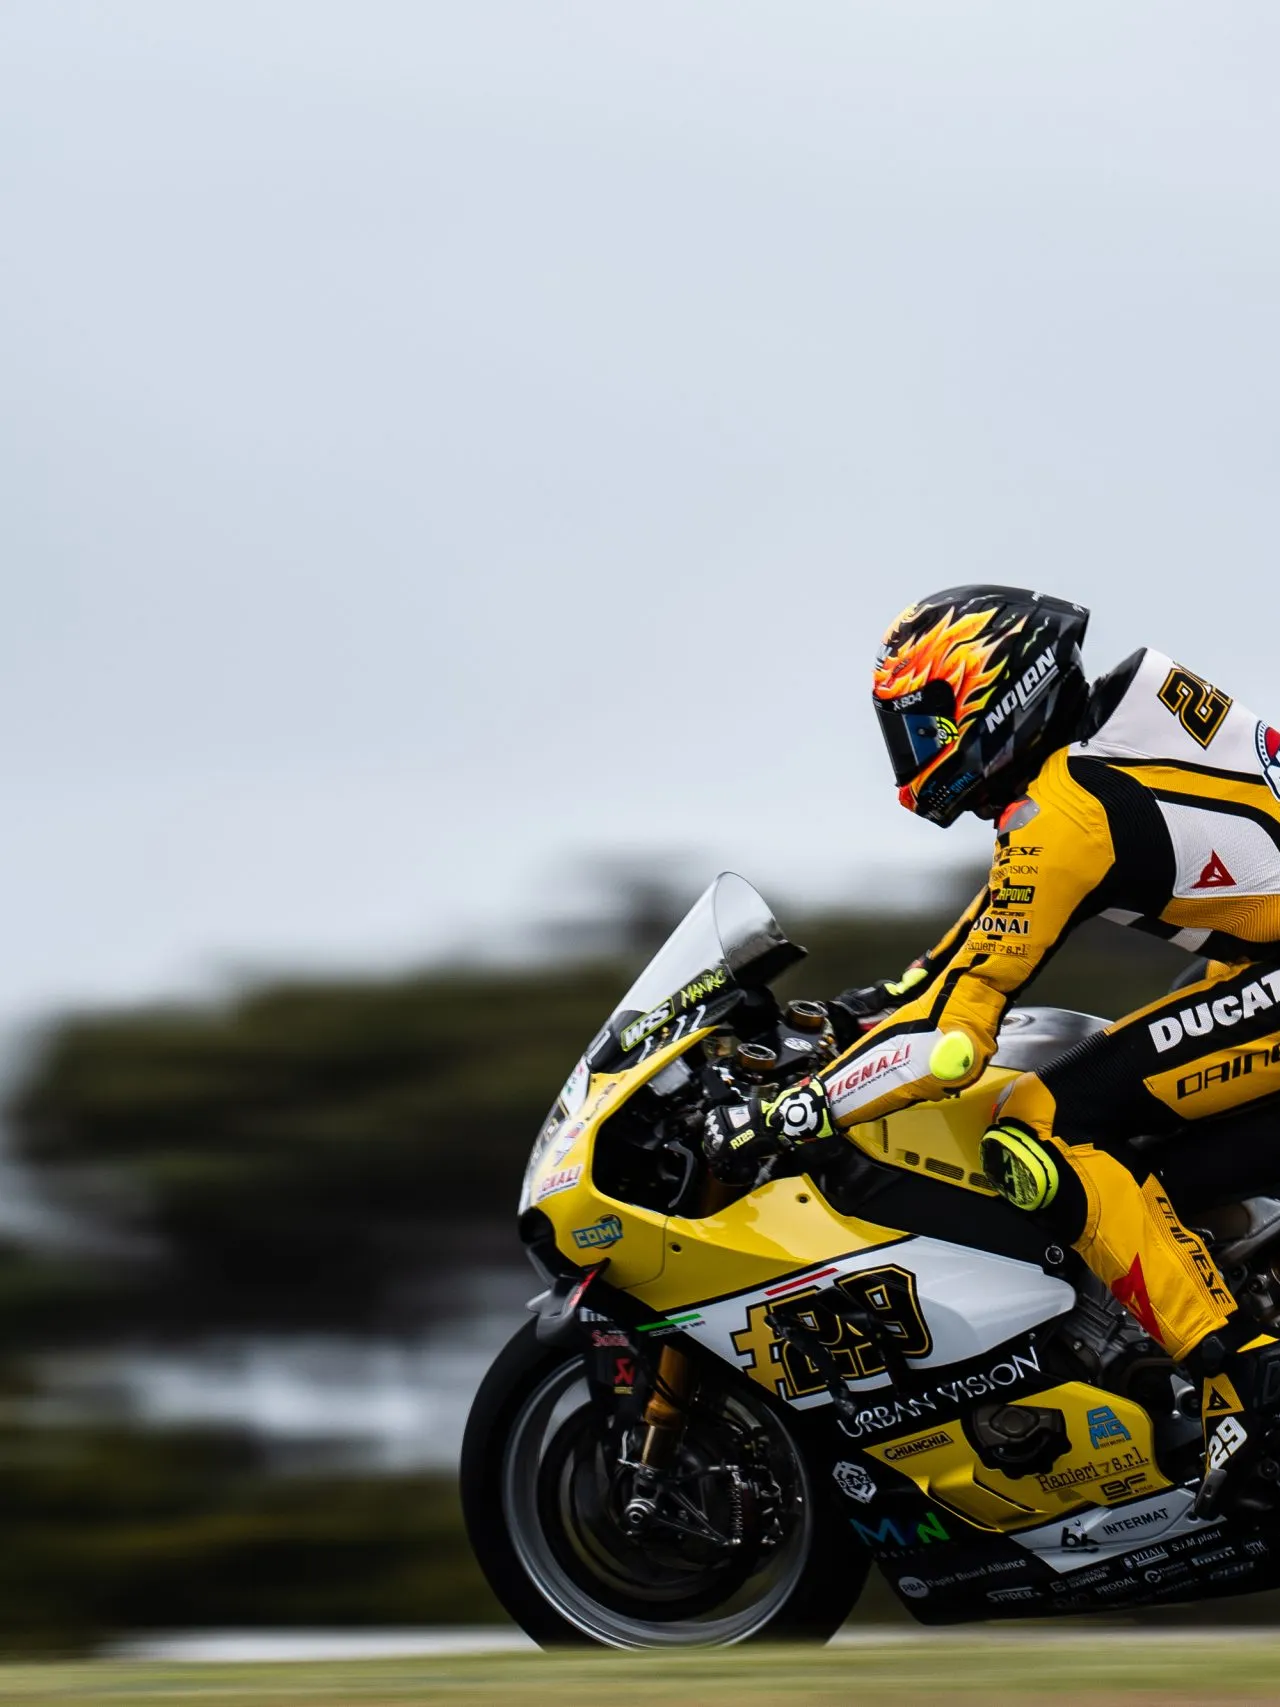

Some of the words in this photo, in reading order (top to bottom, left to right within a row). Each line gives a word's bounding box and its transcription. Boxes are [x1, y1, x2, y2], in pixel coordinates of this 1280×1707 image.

[984, 646, 1059, 732] NOLAN
[1157, 667, 1233, 750] 2
[624, 1001, 671, 1048] WRS
[837, 1391, 937, 1438] URBAN
[936, 1346, 1041, 1403] VISION
[883, 1433, 951, 1462] CHIANCHIA
[1208, 1416, 1248, 1470] 29
[1036, 1461, 1100, 1492] Ranieri
[1102, 1507, 1169, 1536] INTERMAT
[986, 1557, 1027, 1573] Alliance
